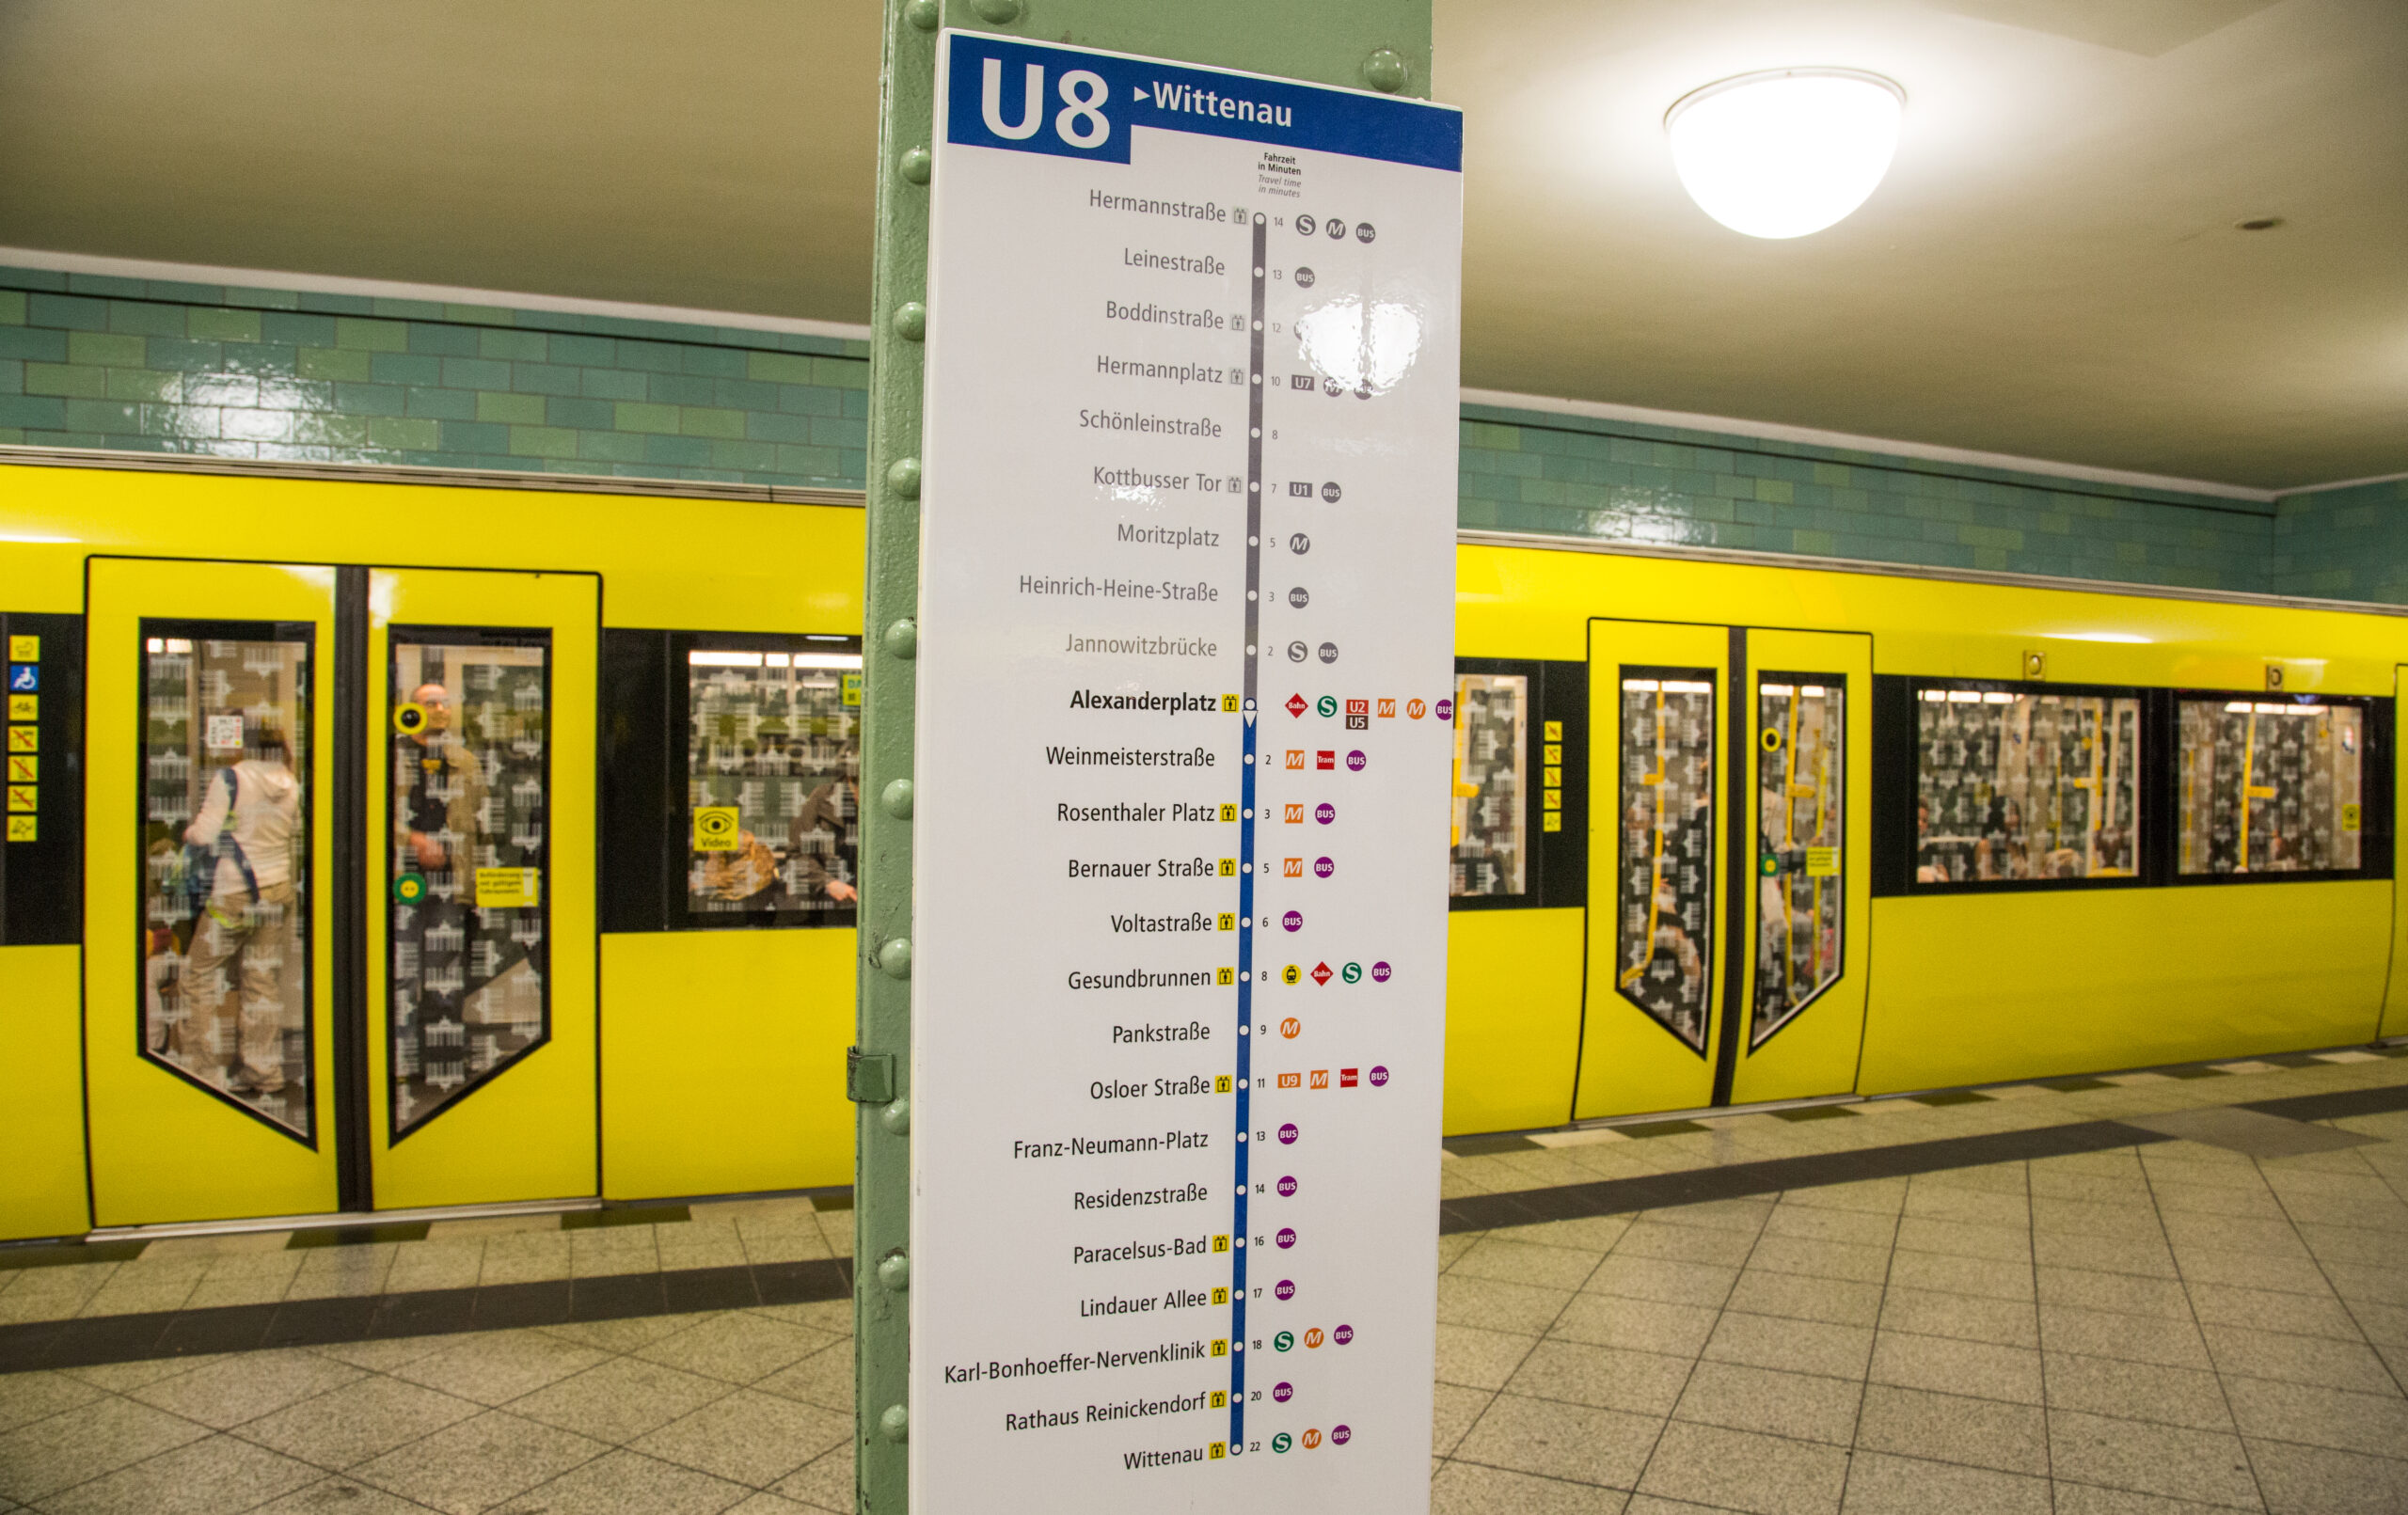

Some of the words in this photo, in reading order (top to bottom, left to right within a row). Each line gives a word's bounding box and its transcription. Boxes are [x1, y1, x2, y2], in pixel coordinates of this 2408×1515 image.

[981, 56, 1111, 149] U8
[1151, 80, 1293, 129] Wittenau
[1263, 151, 1296, 165] Fahrzeit
[1258, 162, 1266, 170] in
[1267, 163, 1302, 176] Minuten
[1257, 173, 1282, 185] Travel
[1283, 178, 1302, 188] time
[1258, 183, 1267, 194] in
[1268, 186, 1301, 198] minutes
[1090, 189, 1226, 222] Hermannstraße
[1274, 216, 1284, 227] 14
[1299, 216, 1313, 234] S
[1327, 221, 1345, 236] M
[1357, 228, 1375, 239] BUS
[1125, 248, 1225, 275] Leinestraße
[1273, 269, 1283, 280] 13
[1296, 273, 1314, 283] BUS
[1107, 301, 1223, 329] Boddinstraße
[1272, 323, 1281, 334] 12
[1098, 355, 1222, 385] Hermannplatz
[1271, 375, 1281, 387] 10
[1295, 376, 1311, 389] U7
[1080, 410, 1221, 437] Schönleinstraße
[1272, 429, 1278, 440] 8
[1094, 466, 1189, 489] Kottbusser
[1196, 472, 1223, 493] Tor
[1271, 482, 1277, 494] 7
[1292, 483, 1307, 497] U1
[1323, 487, 1340, 497] BUS
[1118, 524, 1219, 549] Moritzplatz
[1270, 537, 1276, 548] 5
[1291, 536, 1308, 551] M
[1021, 576, 1217, 601] Heinrich-Heine-Straße
[1268, 591, 1275, 603] 3
[1290, 593, 1308, 603] BUS
[1066, 634, 1216, 656] Jannowitzbrücke
[1267, 645, 1274, 656] 2
[1291, 642, 1306, 661] S
[1320, 648, 1338, 658] BUS
[1070, 689, 1215, 716] Alexanderplatz
[1321, 697, 1335, 716] S
[1349, 701, 1366, 714] U2
[1378, 701, 1396, 715] M
[1407, 702, 1425, 716] M
[1436, 704, 1453, 716] BUS
[1349, 717, 1366, 730] U5
[1045, 746, 1215, 767] Weinmeisterstraße
[1265, 754, 1272, 765] 2
[1286, 752, 1305, 766] M
[1317, 755, 1335, 764] Tram
[1348, 756, 1366, 765] BUS
[1057, 801, 1166, 822] Rosenthaler
[1172, 802, 1215, 822] Platz
[1264, 808, 1271, 820] 3
[1285, 807, 1304, 821] M
[1316, 810, 1335, 819] BUS
[1069, 859, 1151, 878] Bernauer
[1157, 857, 1214, 877] Straße
[1263, 862, 1270, 874] 5
[1284, 860, 1303, 875] M
[1315, 863, 1334, 872] BUS
[1110, 911, 1212, 933] Voltastraße
[1261, 917, 1269, 928] 6
[1284, 917, 1302, 926] BUS
[1069, 969, 1210, 989] Gesundbrunnen
[1260, 971, 1268, 982] 8
[1313, 970, 1331, 978] Bahn
[1345, 964, 1359, 982] S
[1373, 968, 1390, 977] BUS
[1114, 1021, 1210, 1043] Pankstraße
[1259, 1024, 1267, 1035] 9
[1281, 1021, 1299, 1035] M
[1257, 1078, 1265, 1088] 11
[1281, 1075, 1298, 1089] U9
[1310, 1072, 1329, 1086] M
[1340, 1073, 1358, 1081] Tram
[1370, 1071, 1388, 1081] BUS
[1090, 1079, 1149, 1100] Osloer
[1154, 1075, 1211, 1097] Straße
[1256, 1130, 1266, 1142] 13
[1279, 1129, 1297, 1139] BUS
[1015, 1130, 1208, 1159] Franz-Neumann-Platz
[1255, 1183, 1265, 1194] 14
[1278, 1181, 1296, 1191] BUS
[1075, 1183, 1207, 1209] Residenzstraße
[1254, 1236, 1265, 1247] 16
[1277, 1234, 1295, 1243] BUS
[1074, 1236, 1206, 1264] Paracelsus-Bad
[1253, 1287, 1263, 1299] 17
[1276, 1286, 1294, 1295] BUS
[1082, 1296, 1157, 1317] Lindauer
[1164, 1289, 1207, 1310] Allee
[1252, 1339, 1262, 1350] 18
[1277, 1333, 1291, 1350] S
[1306, 1331, 1323, 1345] M
[1335, 1330, 1353, 1340] BUS
[945, 1341, 1205, 1383] Karl-Bonhoeffer-Nervenklinik
[1250, 1390, 1262, 1402] 20
[1275, 1387, 1292, 1397] BUS
[1006, 1410, 1079, 1430] Rathaus
[1087, 1392, 1206, 1422] Reinickendorf
[1249, 1441, 1261, 1453] 22
[1275, 1434, 1290, 1452] S
[1303, 1431, 1321, 1446] M
[1333, 1429, 1350, 1441] BUS
[1124, 1448, 1202, 1469] Wittenau
